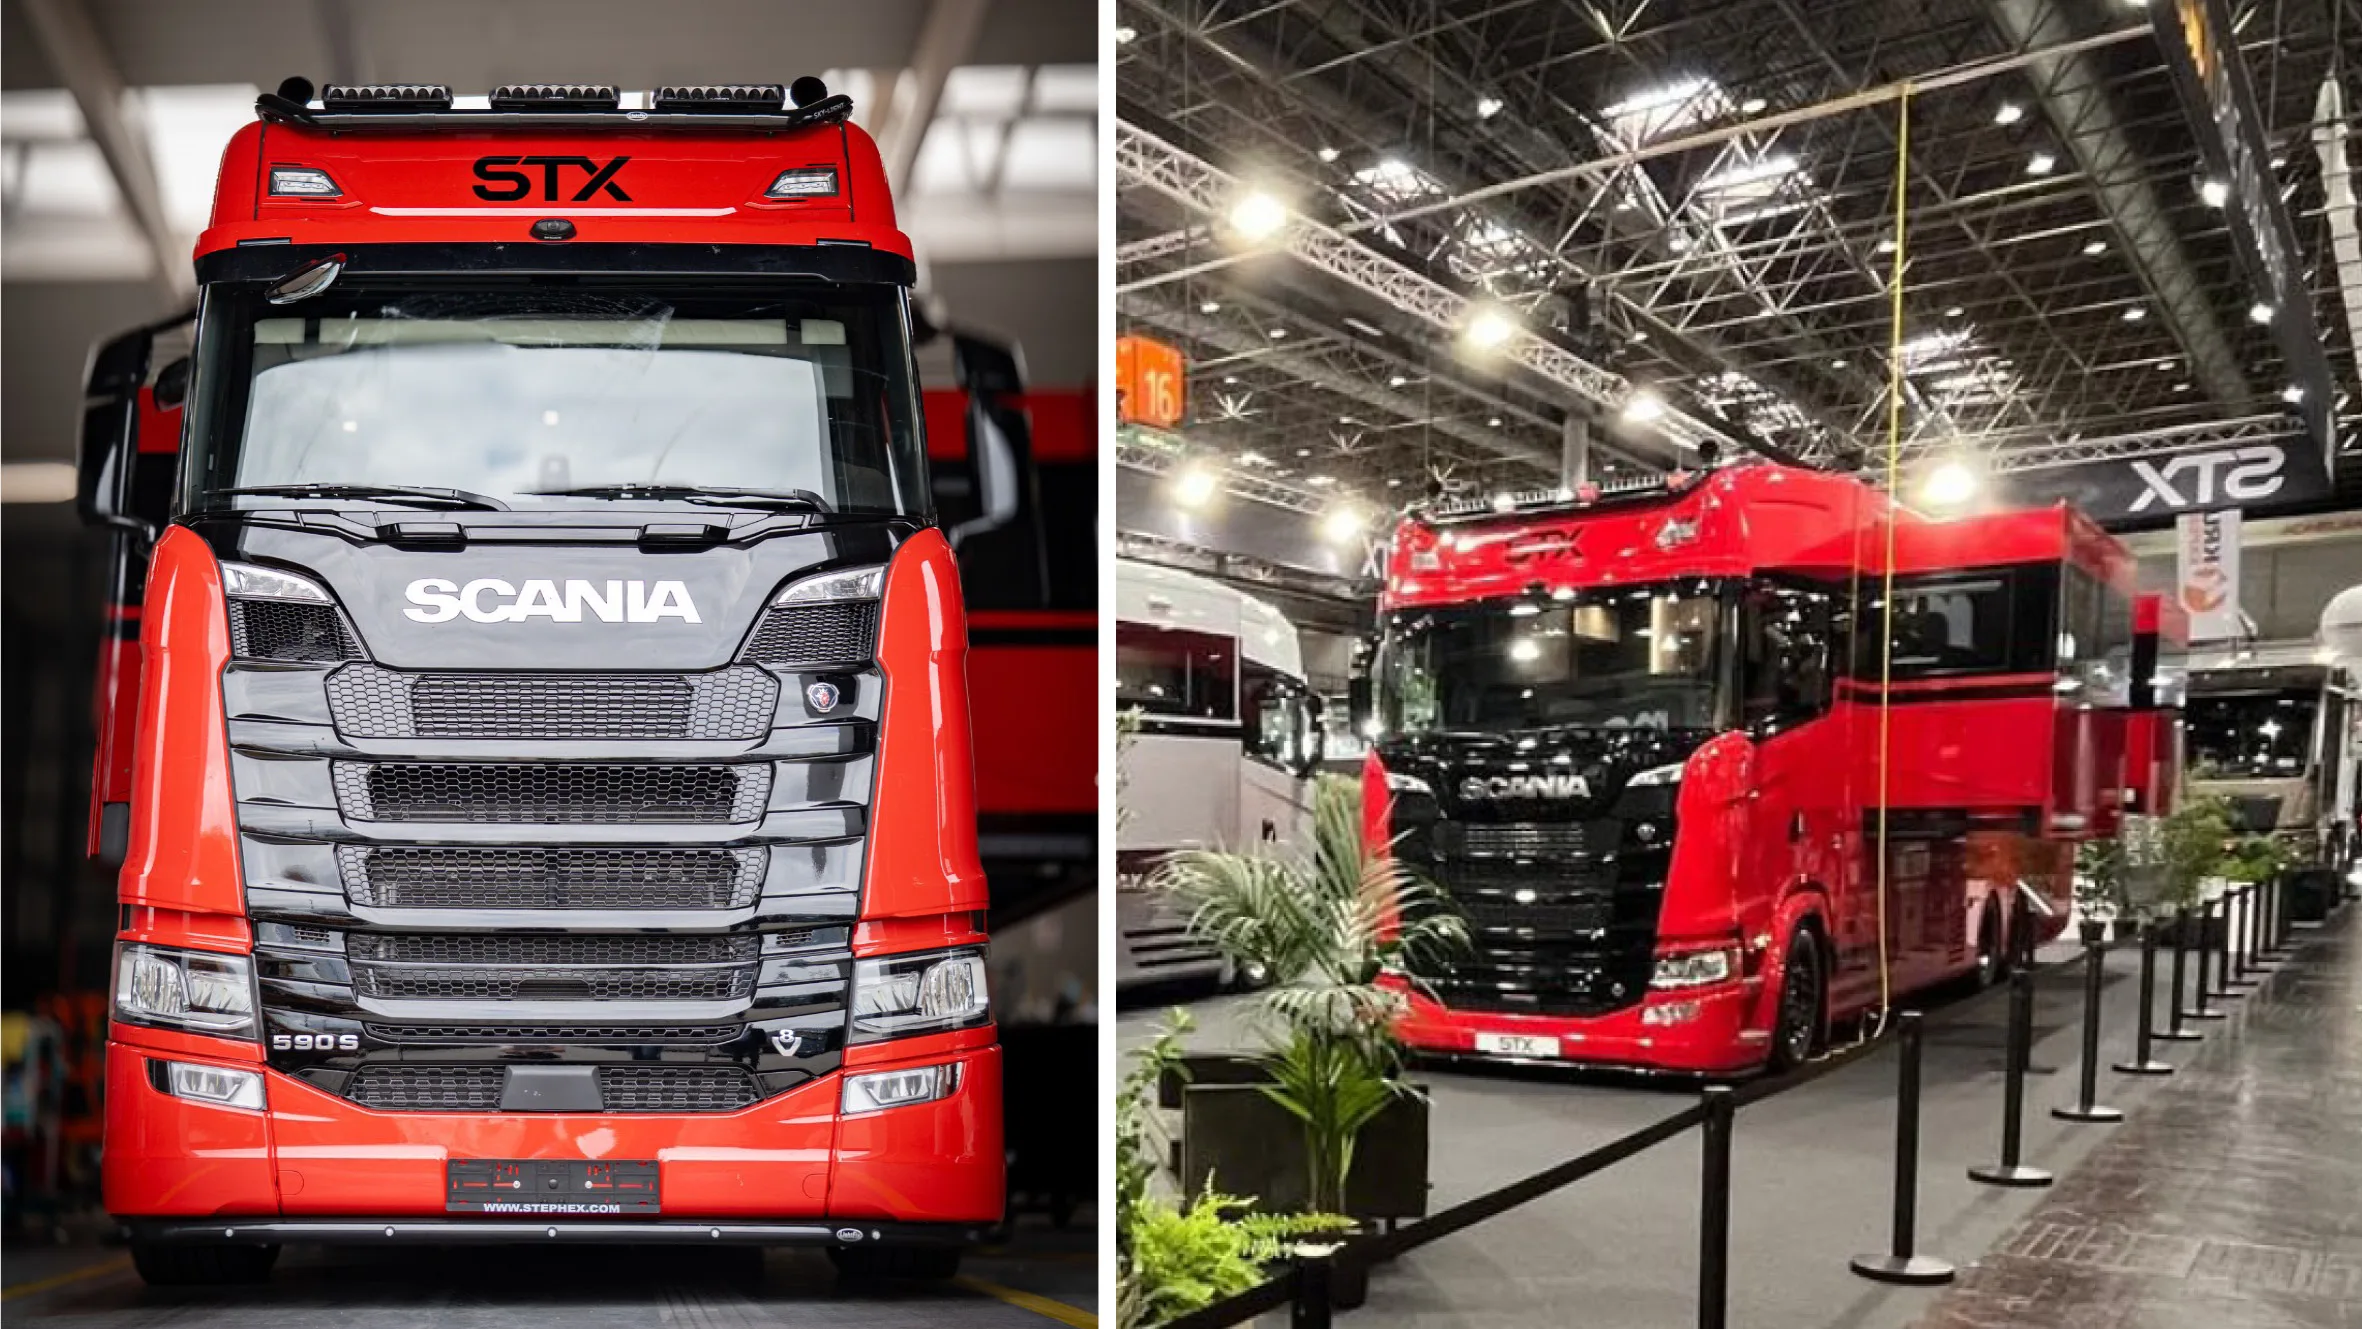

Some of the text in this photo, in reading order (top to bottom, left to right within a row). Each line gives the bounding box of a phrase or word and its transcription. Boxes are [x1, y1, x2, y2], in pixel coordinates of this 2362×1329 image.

[472, 155, 633, 202] STX
[1143, 370, 1174, 420] 16
[402, 578, 703, 624] SCANIA
[1459, 775, 1592, 800] SCANIA
[273, 1034, 359, 1050] 590 S
[1499, 1036, 1534, 1051] STX
[484, 1203, 620, 1213] WWW.STEPHEX.COM
